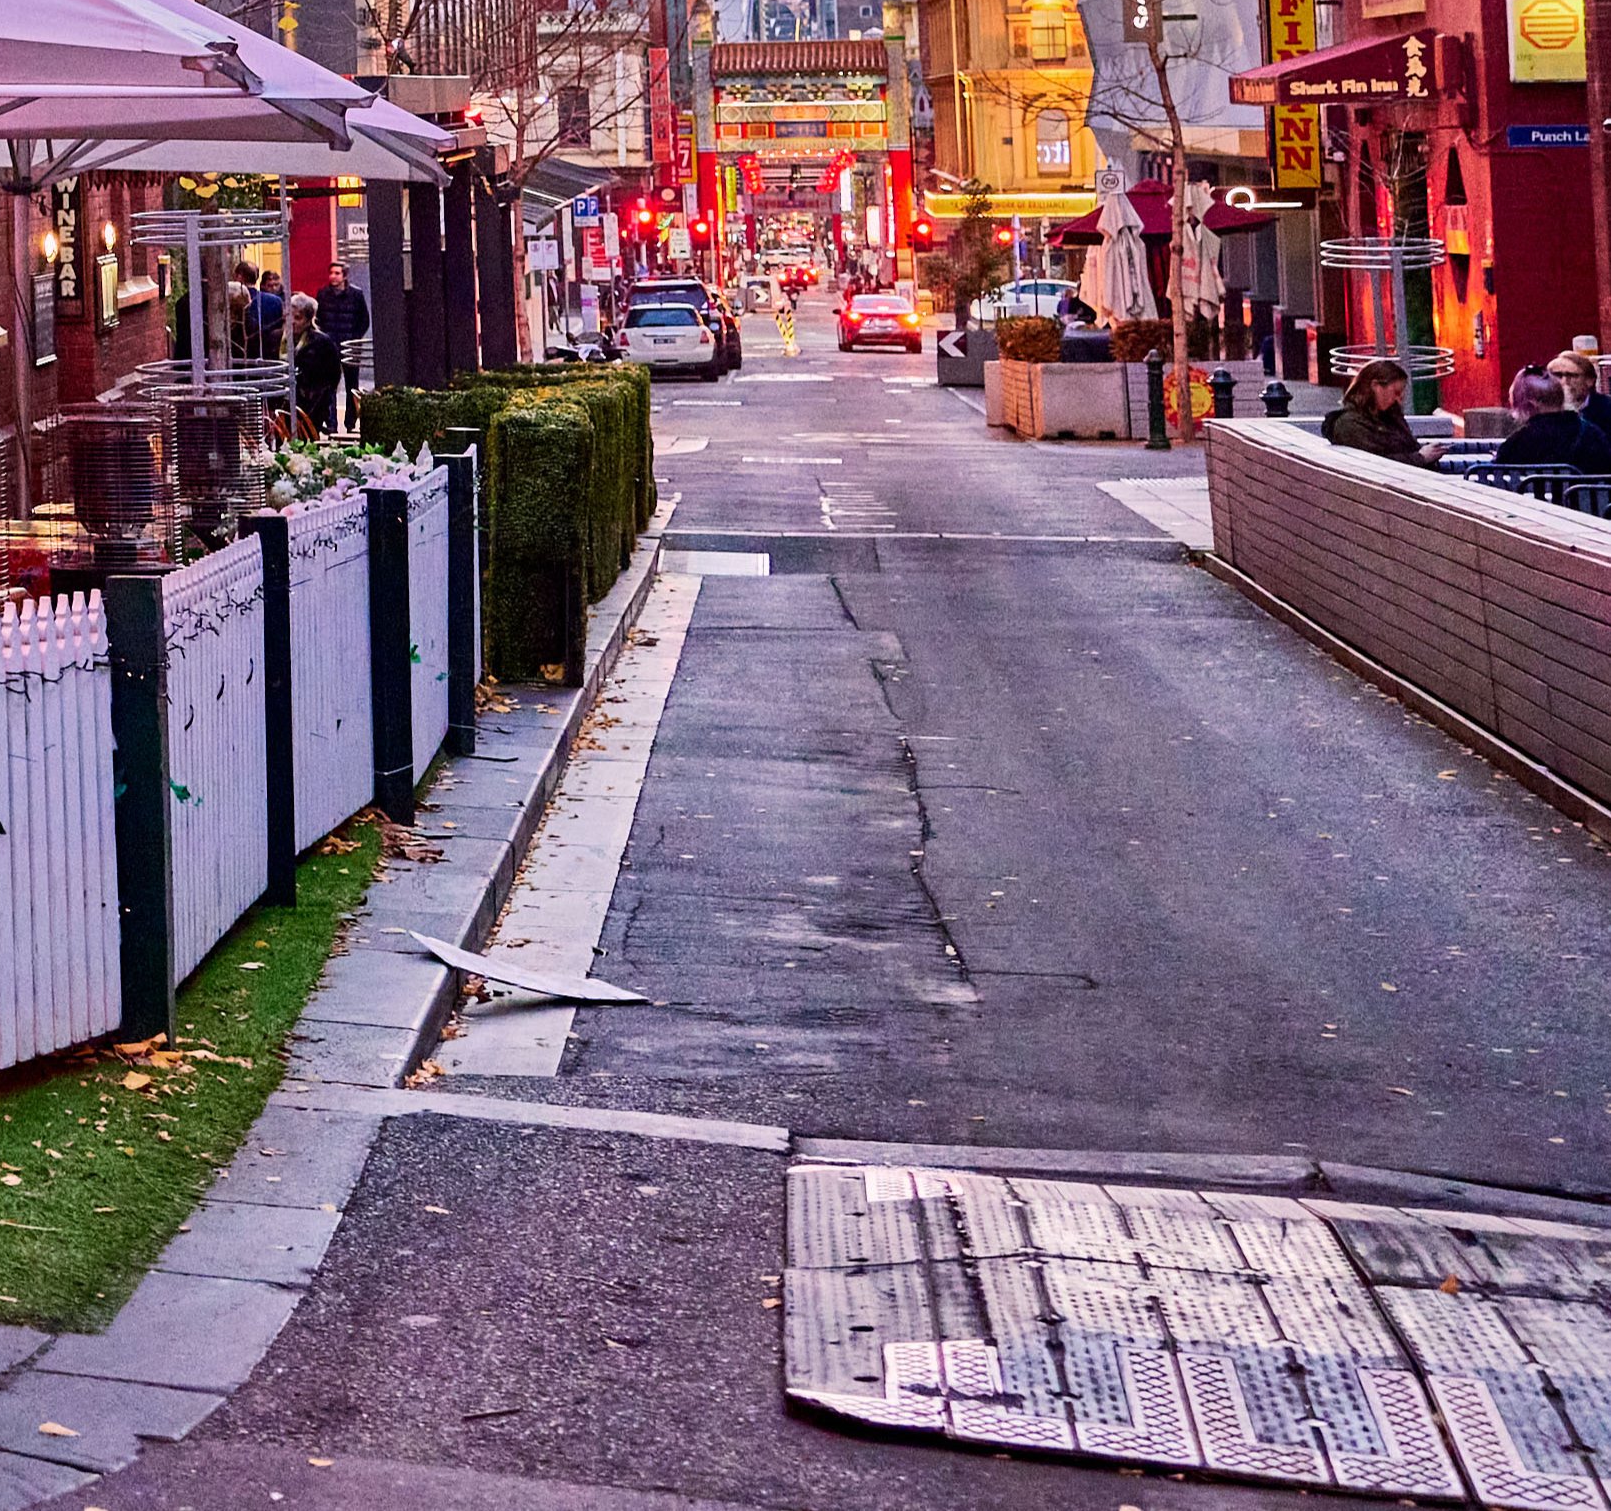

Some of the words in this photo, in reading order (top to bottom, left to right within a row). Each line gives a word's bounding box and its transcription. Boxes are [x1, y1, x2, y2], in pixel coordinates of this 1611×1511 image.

[1289, 79, 1339, 96] Shark
[1341, 78, 1368, 94] Fin
[1370, 78, 1399, 93] Inn
[1531, 129, 1572, 143] Punch
[56, 176, 79, 242] WINE
[60, 246, 78, 297] BAR
